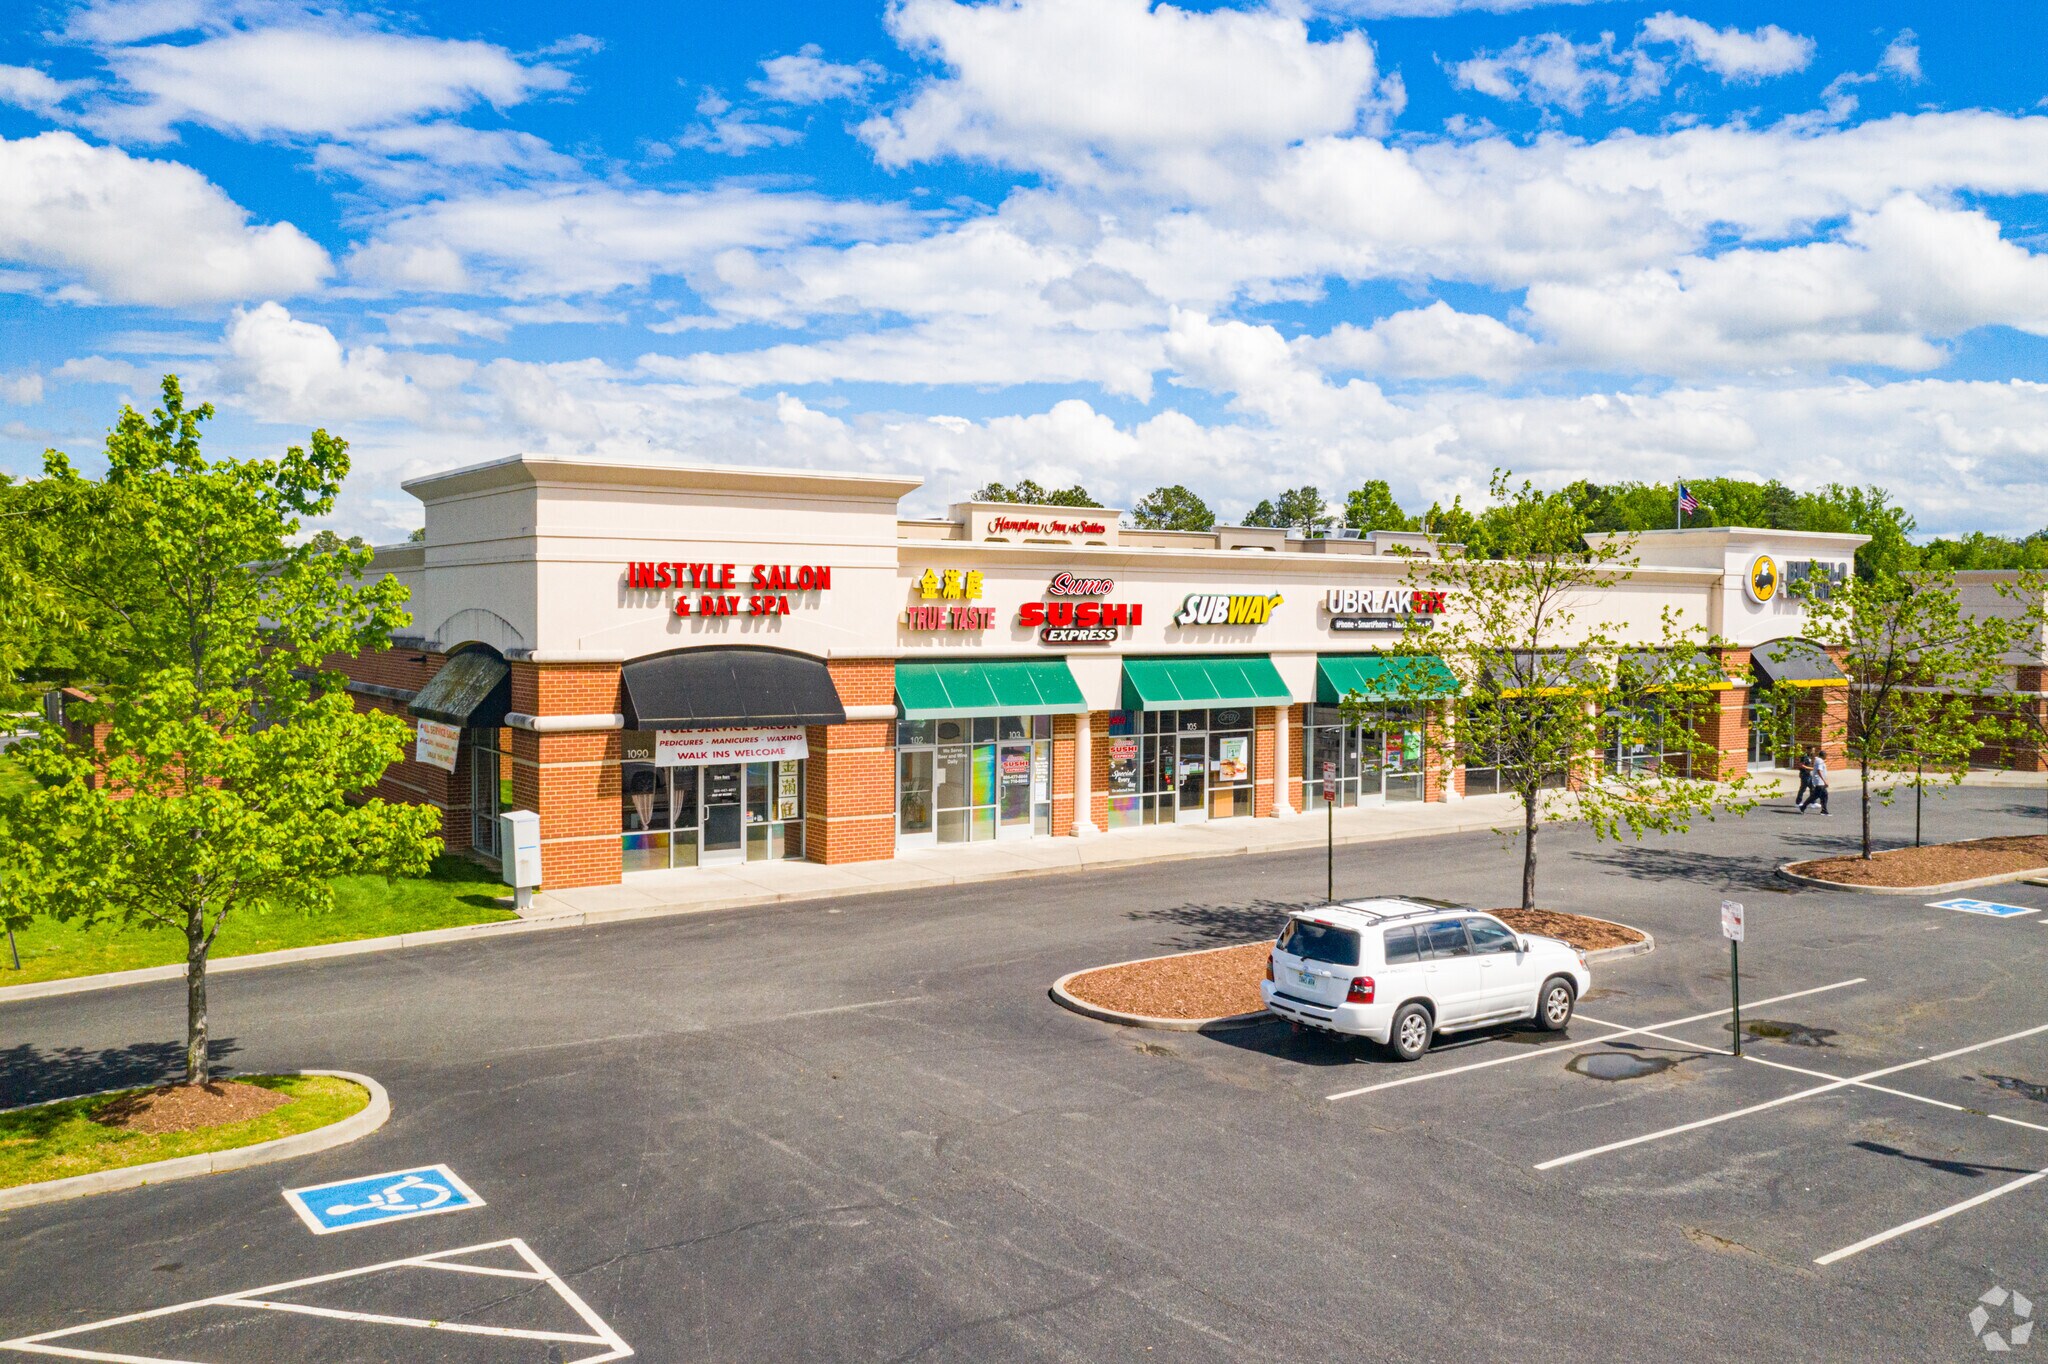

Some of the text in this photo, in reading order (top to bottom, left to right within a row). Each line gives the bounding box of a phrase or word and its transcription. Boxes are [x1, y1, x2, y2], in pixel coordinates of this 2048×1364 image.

[988, 517, 1043, 535] Hampton
[1043, 520, 1070, 534] Inn
[1076, 521, 1106, 533] Suites
[628, 562, 831, 590] INSTYLE SALON
[1050, 571, 1114, 596] Sumo
[675, 596, 791, 617] & DAY SPA
[1179, 593, 1285, 626] SUBWAY
[907, 606, 996, 631] TRUE TASTE
[1019, 602, 1143, 627] SUSHI
[1336, 620, 1354, 628] iPhone
[1358, 620, 1388, 628] SmartPhone
[1048, 628, 1116, 642] EXPRESS
[1186, 722, 1197, 731] 105
[659, 734, 803, 747] PEDICURES MANICURES WAXING
[910, 736, 924, 744] 102
[1009, 731, 1021, 739] 103
[627, 749, 649, 759] 1090
[677, 747, 786, 760] WALK INS WELCOME
